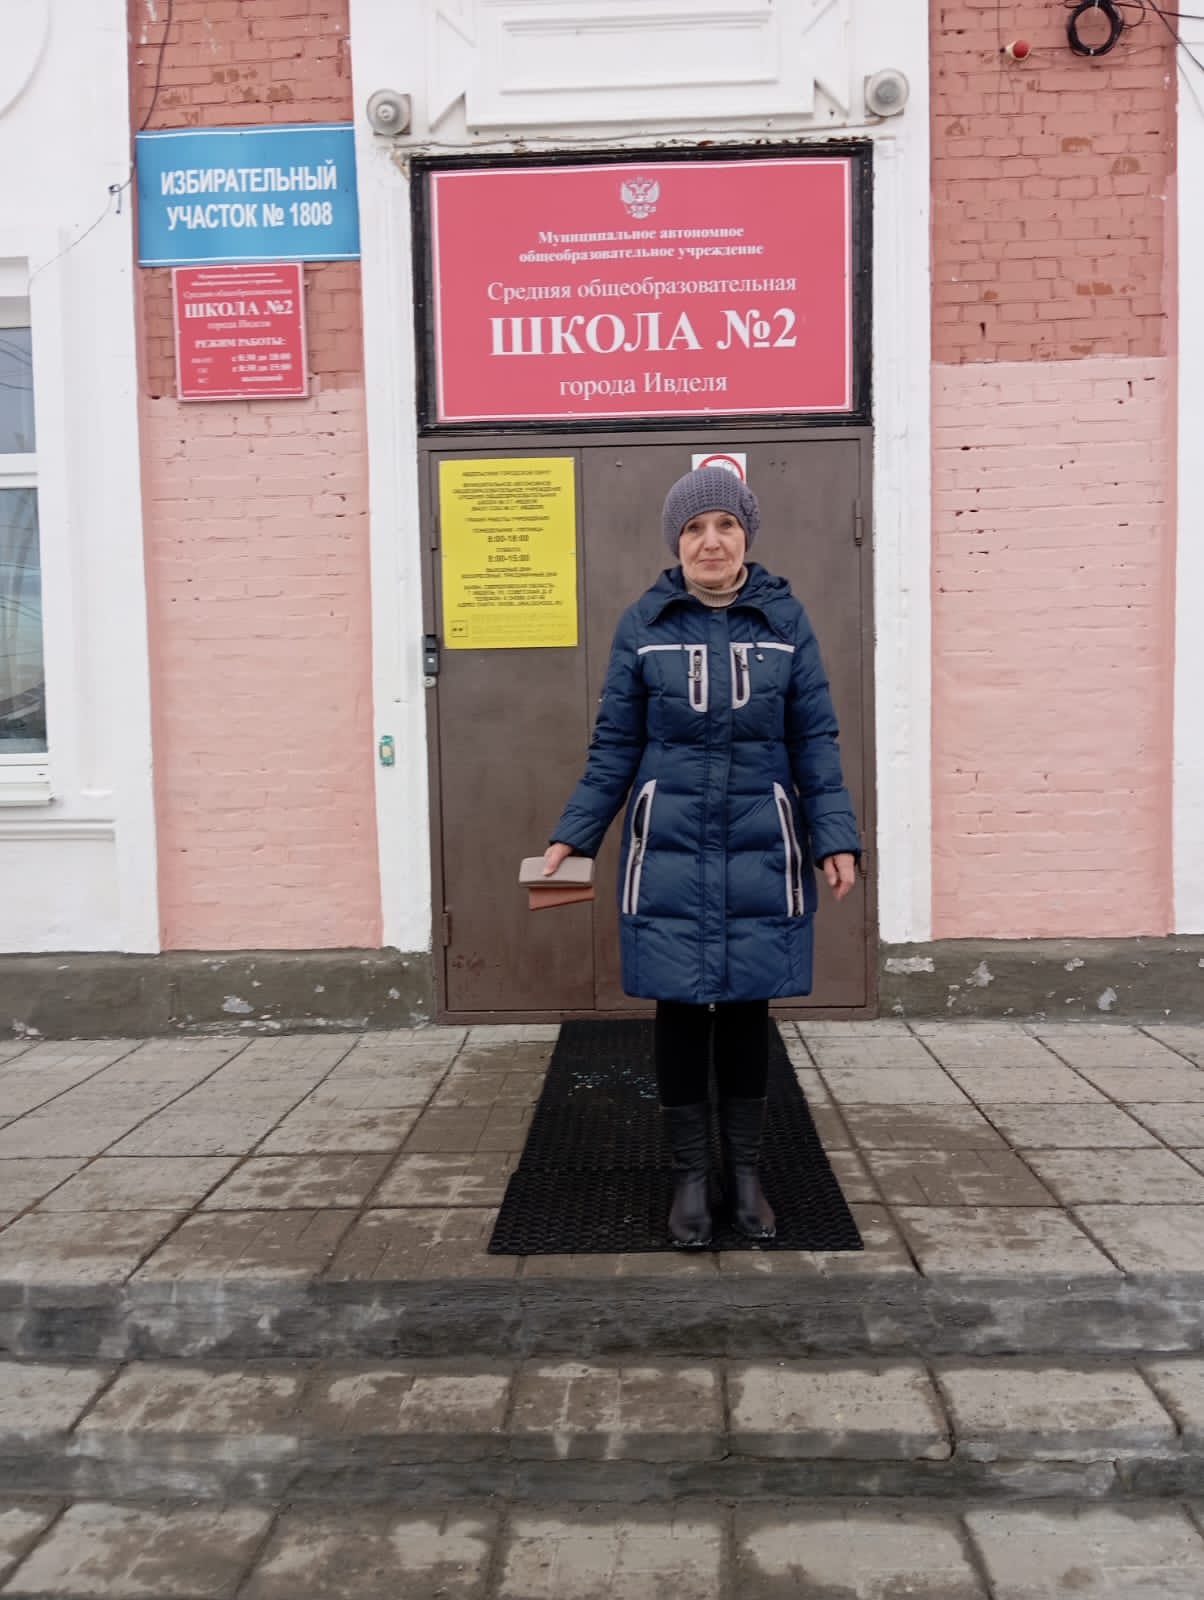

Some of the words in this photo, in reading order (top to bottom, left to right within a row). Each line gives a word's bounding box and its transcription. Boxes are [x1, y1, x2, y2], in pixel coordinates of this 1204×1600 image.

[160, 159, 338, 196] ИЗБИРАТЕЛЬНЫЙ
[167, 203, 258, 231] УЧАСТОК
[262, 203, 285, 227] №
[289, 201, 333, 226] 1808
[538, 227, 656, 246] Муниципальное
[659, 226, 744, 241] автономное
[519, 245, 674, 264] общеобразовательное
[678, 242, 764, 260] учреждение
[487, 282, 571, 305] Средняя
[577, 276, 797, 300] общеобразовательная
[183, 300, 260, 318] ШКОЛА
[263, 299, 294, 316] №2
[489, 311, 704, 356] ШКОЛА
[716, 307, 798, 350] №2
[560, 377, 636, 401] города
[643, 372, 728, 394] Ивделя
